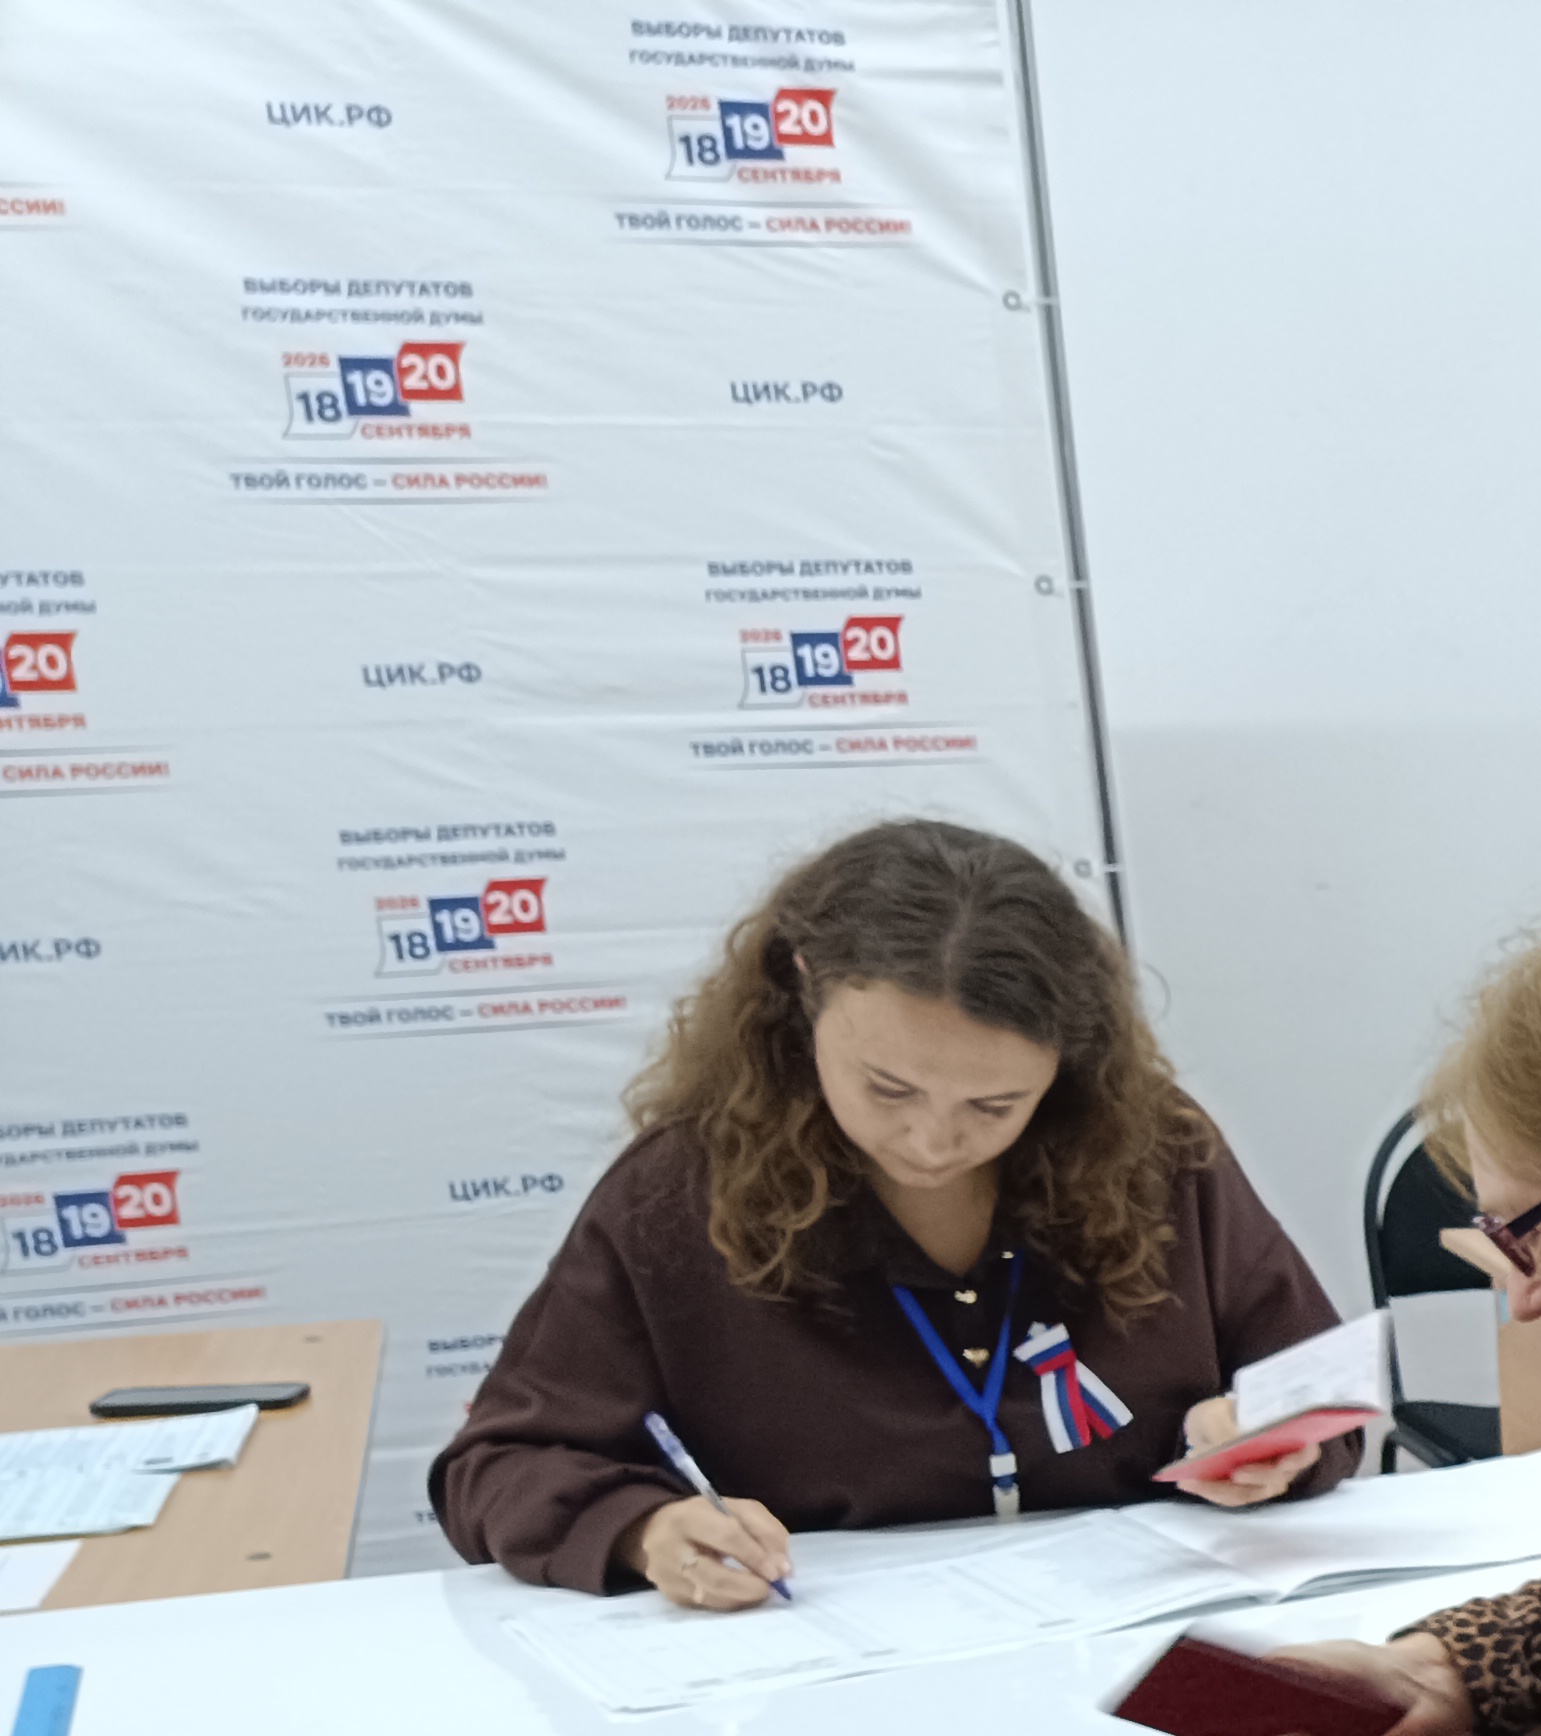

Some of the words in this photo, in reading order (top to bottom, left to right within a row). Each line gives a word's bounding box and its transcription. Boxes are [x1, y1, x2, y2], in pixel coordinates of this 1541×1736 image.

[631, 20, 722, 40] ВЫБОРЫ
[728, 24, 846, 46] ДЕПУТАТОВ
[629, 50, 800, 71] ГОСУДАРСТВЕННОЙ
[804, 58, 855, 72] ДУМЫ
[266, 101, 392, 128] ЦИК.РФ
[679, 133, 720, 166] 18
[726, 113, 770, 150] 19
[776, 100, 828, 136] 20
[737, 167, 841, 184] СЕНТЯБРЯ
[614, 210, 670, 231] ТВОЙ
[676, 214, 744, 232] ГОЛОС
[766, 215, 820, 234] СИЛА
[243, 277, 341, 297] ВЫБОРЫ
[347, 279, 474, 299] ДЕПУТАТОВ
[241, 306, 425, 325] ГОСУДАРСТВЕННОЙ
[430, 310, 484, 326] ДУМЫ
[282, 352, 330, 367] 2026
[296, 390, 342, 424] 18
[347, 369, 393, 407] 19
[401, 354, 455, 389] 20
[730, 381, 843, 405] ЦИК.РФ
[360, 423, 472, 439] СЕНТЯБРЯ
[230, 469, 290, 490] ТВОЙ
[295, 473, 368, 490] ГОЛОС
[392, 473, 451, 490] СИЛА
[707, 560, 795, 577] ВЫБОРЫ
[799, 559, 914, 577] ДЕПУТАТОВ
[705, 586, 869, 603] ГОСУДАРСТВЕННОЙ
[873, 587, 922, 601] ДУМЫ
[8, 644, 68, 682] 20
[752, 664, 792, 695] 18
[797, 644, 840, 677] 19
[845, 627, 895, 661] 20
[362, 662, 482, 690] ЦИК.РФ
[809, 691, 909, 708] СЕНТЯБРЯ
[690, 739, 745, 758] ТВОЙ
[748, 739, 814, 755] ГОЛОС
[836, 736, 888, 754] СИЛА
[2, 763, 65, 783] СИЛА
[339, 826, 431, 846] ВЫБОРЫ
[437, 821, 556, 842] ДЕПУТАТОВ
[337, 848, 509, 871] ГОСУДАРСТВЕННОЙ
[513, 848, 567, 865] ДУМЫ
[389, 931, 430, 961] 18
[435, 908, 480, 943] 19
[487, 890, 538, 924] 20
[449, 954, 554, 974] СЕНТЯБРЯ
[325, 1007, 382, 1028] ТВОЙ
[387, 1005, 455, 1022] ГОЛОС
[477, 1000, 532, 1019] СИЛА
[61, 1113, 188, 1137] ДЕПУТАТОВ
[449, 1173, 564, 1202] ЦИК.РФ
[12, 1228, 58, 1258] 18
[62, 1203, 110, 1239] 19
[116, 1183, 172, 1219] 20
[13, 1302, 86, 1321] ГОЛОС
[110, 1296, 168, 1313] СИЛА
